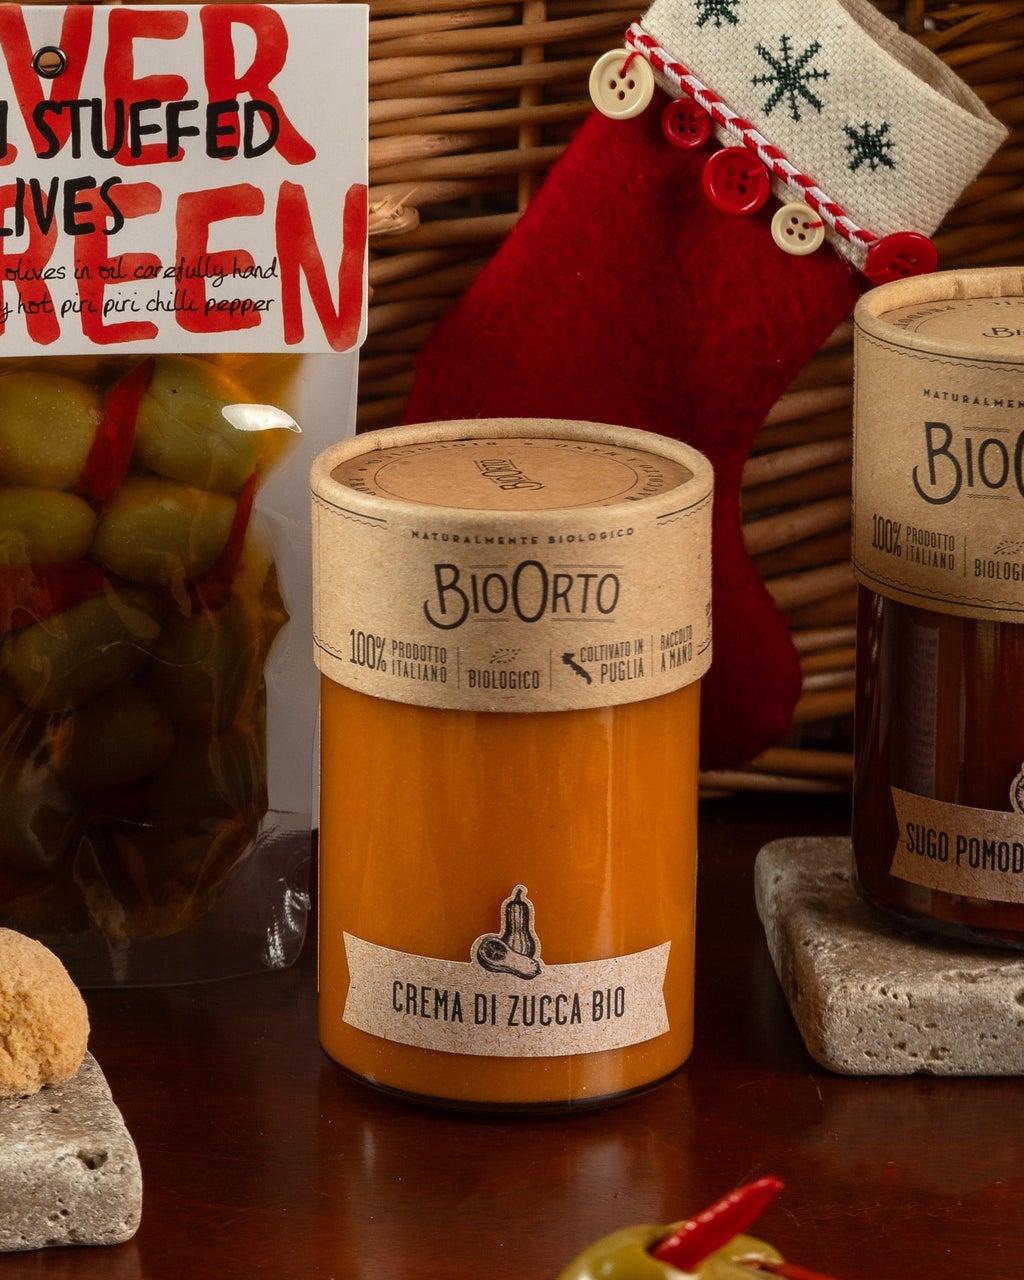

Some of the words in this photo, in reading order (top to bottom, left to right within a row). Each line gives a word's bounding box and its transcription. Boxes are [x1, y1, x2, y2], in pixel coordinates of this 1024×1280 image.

[32, 97, 281, 160] STUFFED
[5, 258, 66, 282] olives
[74, 258, 93, 280] in
[99, 256, 127, 279] oil
[133, 256, 227, 288] carefully
[232, 256, 279, 279] hand
[17, 291, 54, 314] hot
[61, 292, 98, 318] piri
[103, 291, 141, 318] piri
[145, 290, 199, 312] chilli
[203, 297, 275, 317] pepper
[411, 530, 538, 546] NATURALMENTE
[547, 527, 634, 545] BIOLOGICO
[871, 513, 902, 558] 100%
[906, 526, 955, 552] PRODOTTO
[906, 544, 955, 571] ITALIANO
[349, 628, 387, 673] 100%
[391, 639, 447, 664] PRODOTTO
[579, 640, 631, 663] COLTIVATO
[634, 637, 644, 656] IN
[660, 624, 693, 651] RACCOLTO
[391, 659, 447, 684] ITALIANO
[600, 657, 645, 685] PUGLIA
[660, 652, 666, 673] A
[669, 642, 693, 670] MANO
[467, 668, 541, 690] BIOLOGICO
[905, 822, 949, 862] SUGO
[392, 980, 464, 1023] CREMA
[474, 993, 497, 1026] DI
[507, 992, 582, 1027] ZUCCA
[592, 986, 626, 1022] BIO
